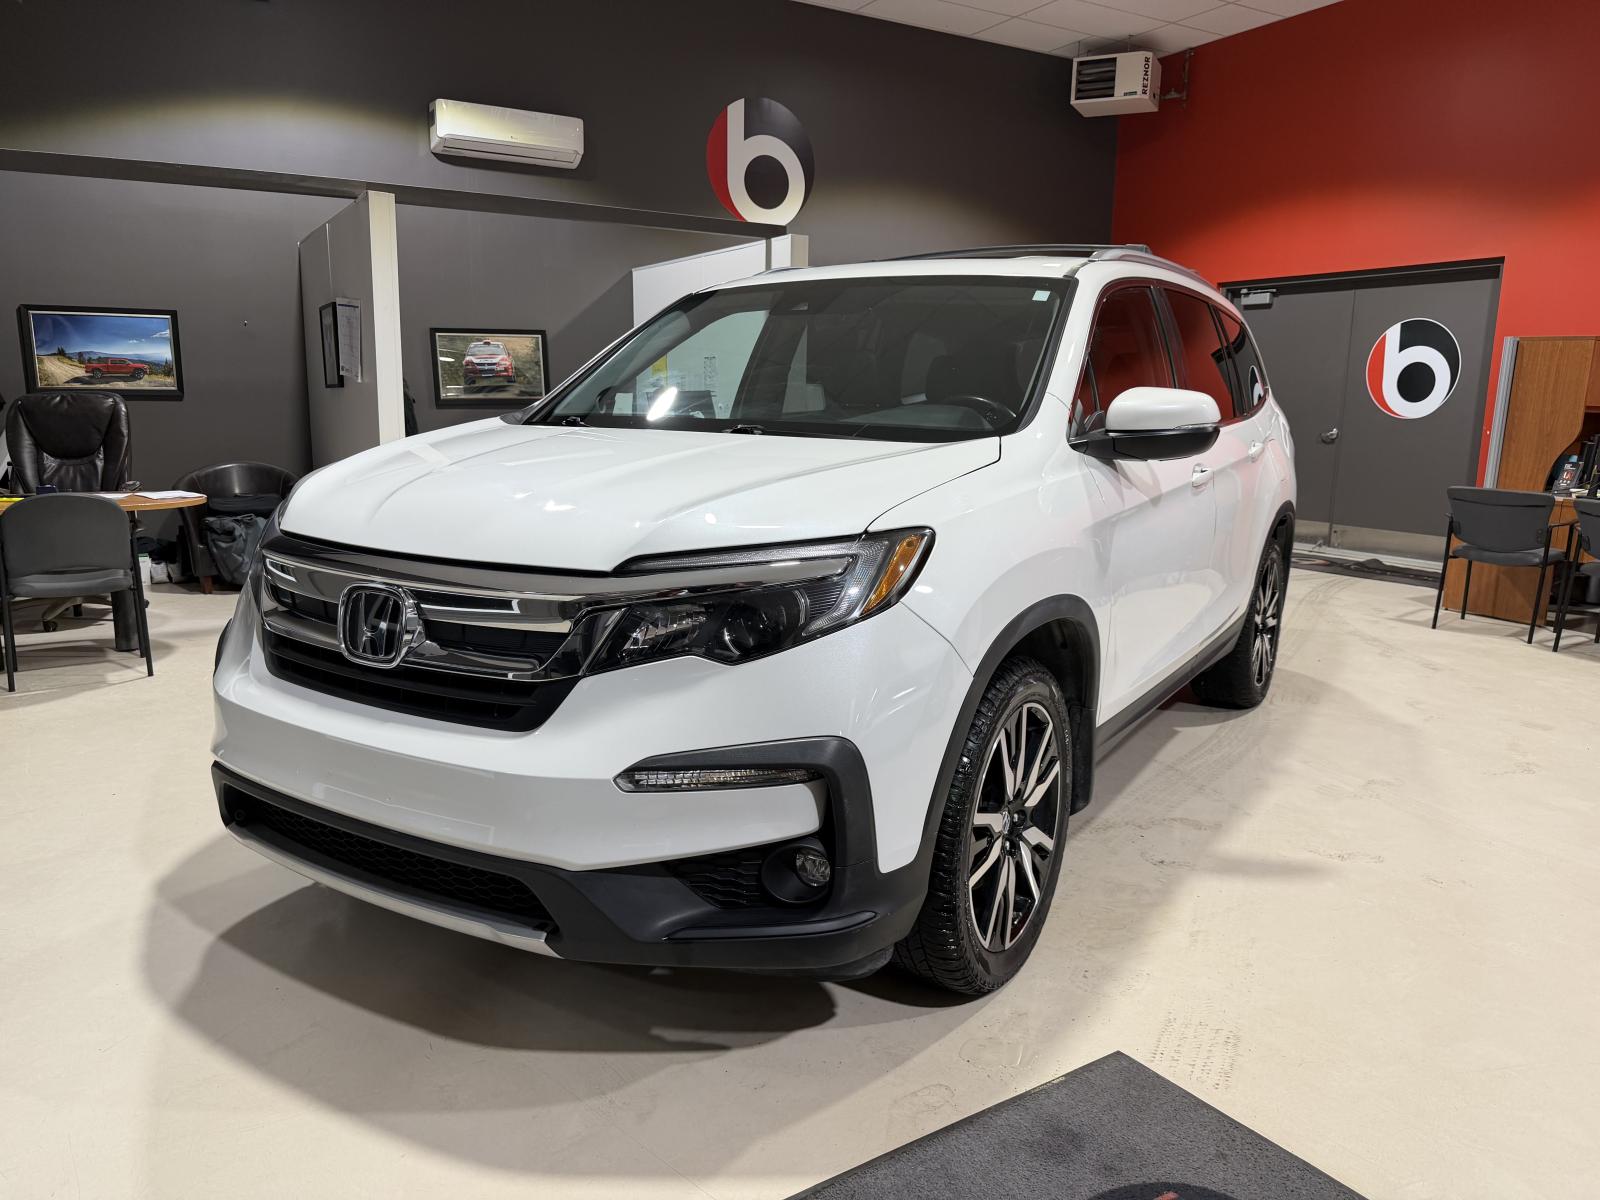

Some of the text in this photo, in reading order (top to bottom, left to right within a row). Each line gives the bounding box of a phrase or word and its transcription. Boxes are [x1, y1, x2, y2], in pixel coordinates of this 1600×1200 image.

[1142, 56, 1150, 95] REZNOR
[727, 97, 806, 226] b
[1382, 320, 1451, 419] b
